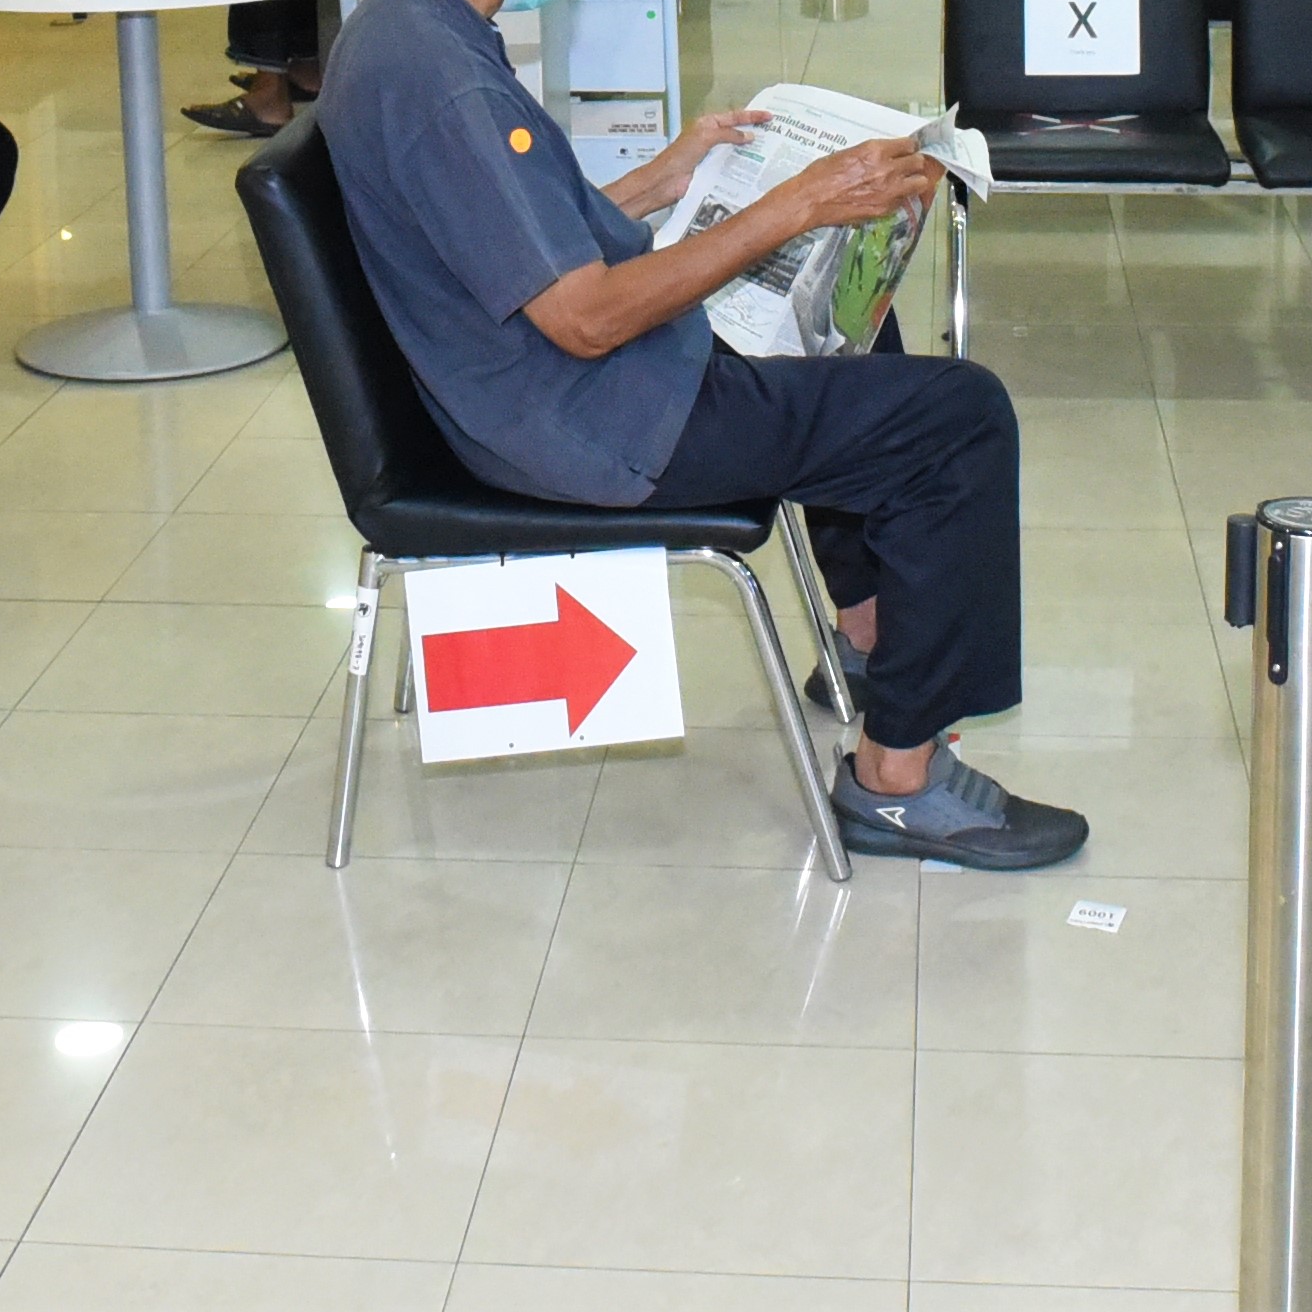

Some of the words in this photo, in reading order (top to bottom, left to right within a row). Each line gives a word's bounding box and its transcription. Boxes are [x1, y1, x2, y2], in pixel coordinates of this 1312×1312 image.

[1068, 1, 1098, 39] X
[753, 121, 782, 134] njak
[785, 126, 816, 148] harga
[772, 114, 817, 135] rmintaan
[818, 129, 848, 147] pulih
